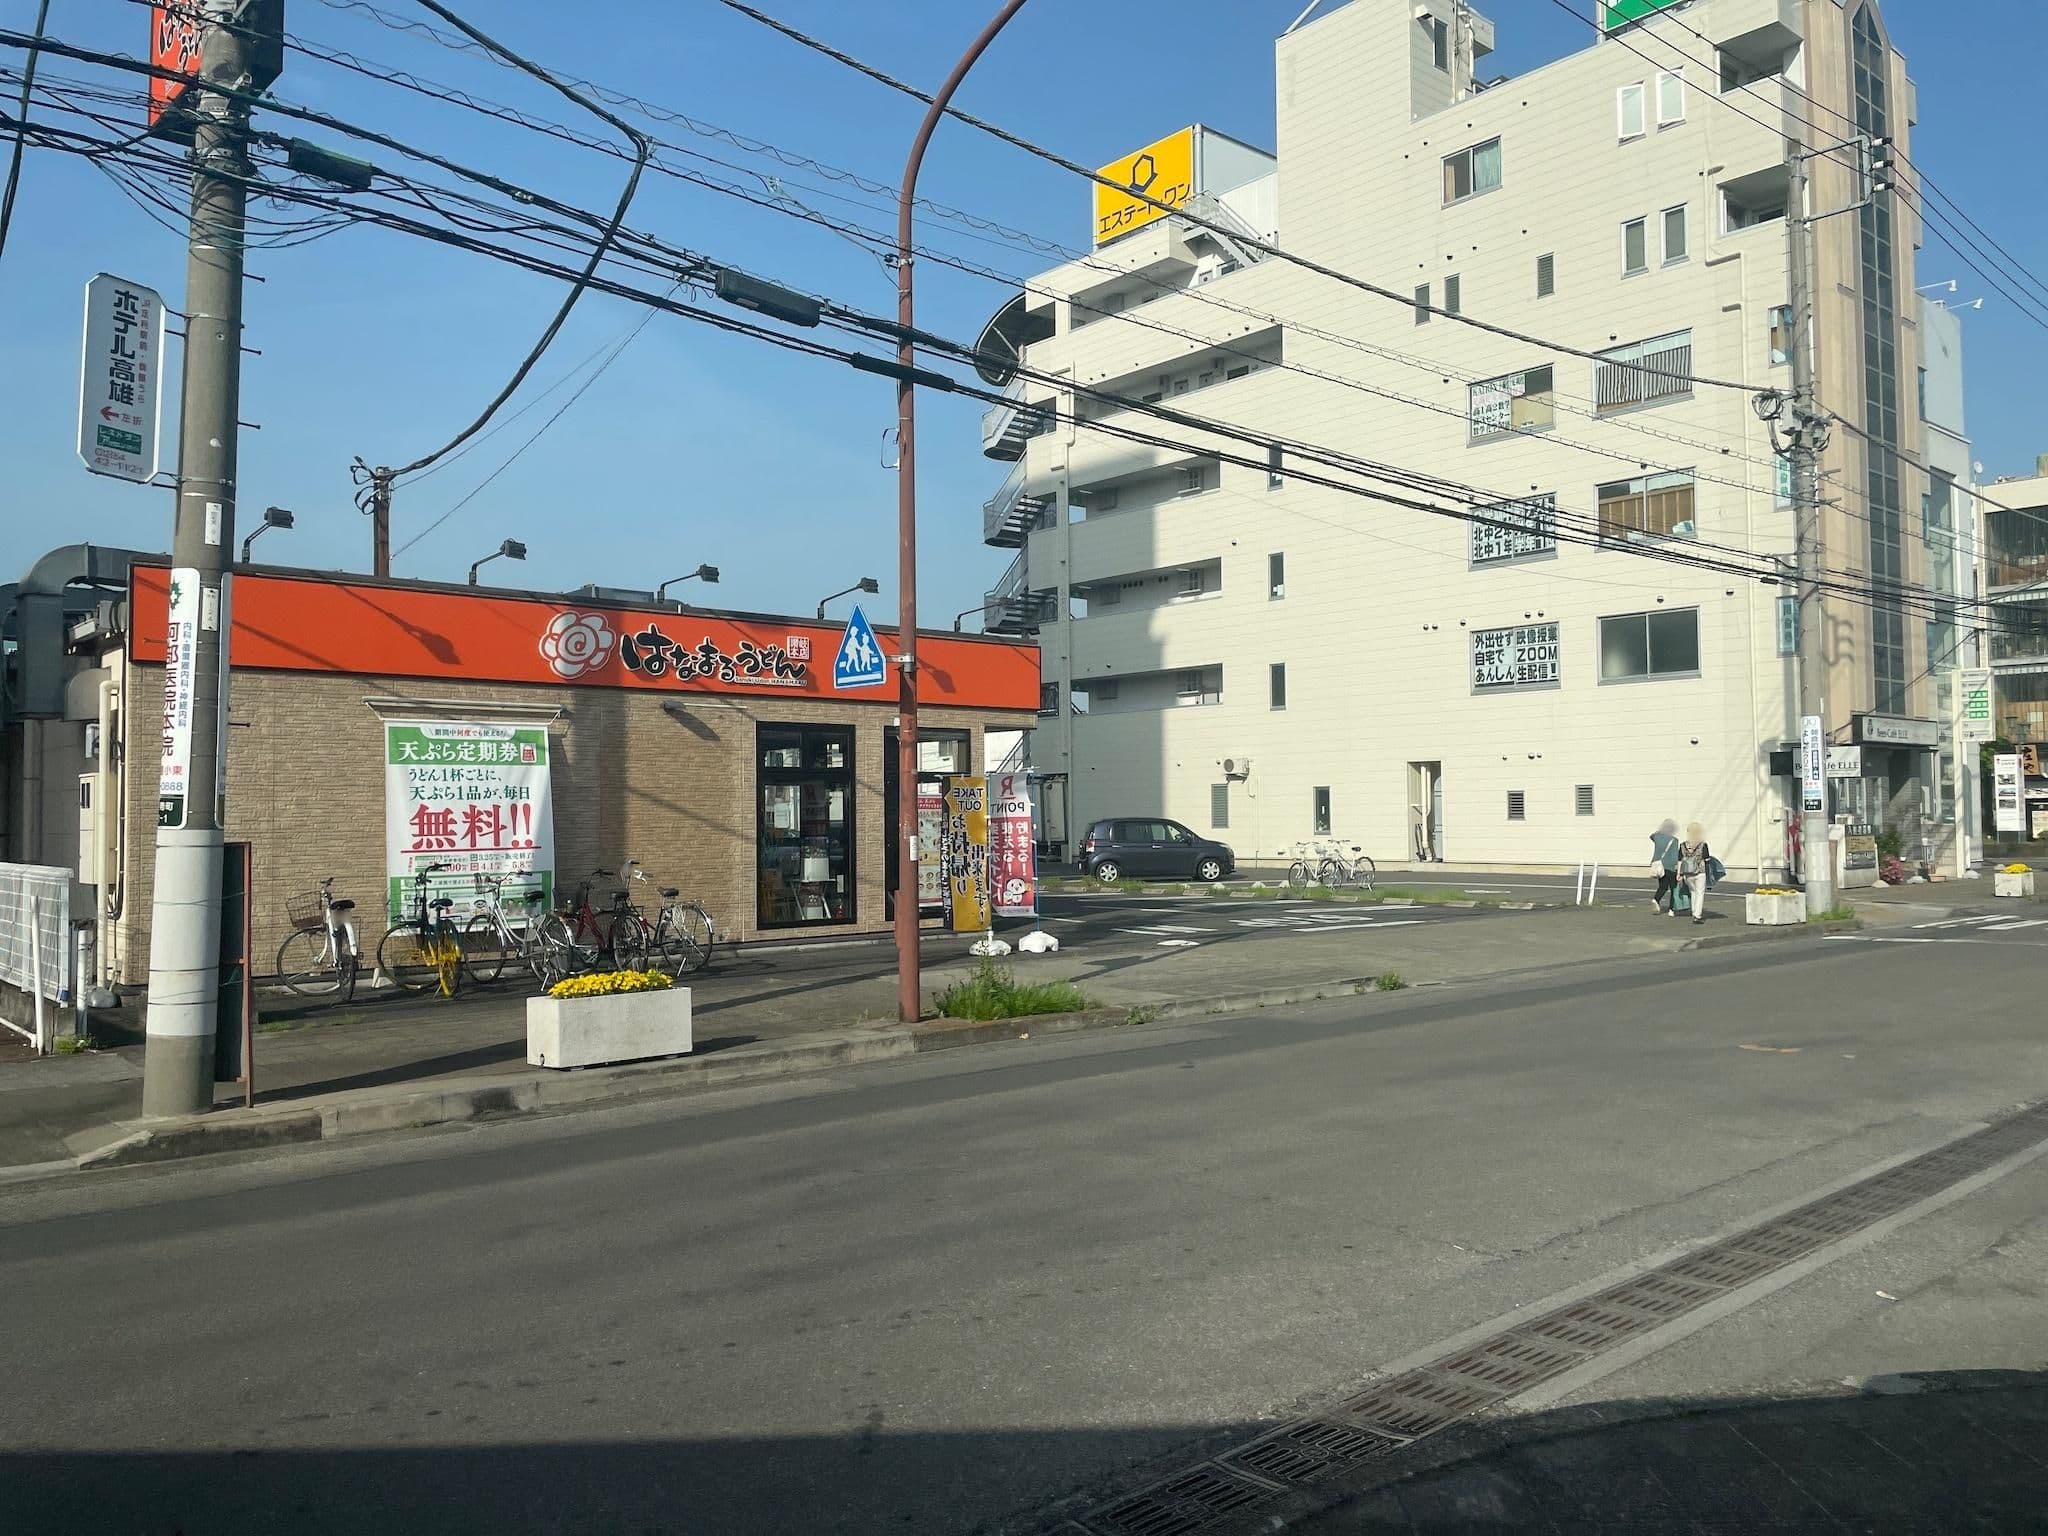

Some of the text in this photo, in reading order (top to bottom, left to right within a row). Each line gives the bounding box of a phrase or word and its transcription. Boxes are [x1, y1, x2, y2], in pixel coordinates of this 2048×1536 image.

[109, 289, 140, 406] ホテル高雄
[1473, 540, 1512, 558] 北中1年
[1475, 632, 1513, 649] 外出せず
[620, 623, 807, 683] はなまるうどん
[1475, 649, 1504, 666] 自宅で
[1517, 646, 1558, 662] ZOOM
[1475, 666, 1515, 682] あんしん
[398, 741, 519, 762] 天ぷら定期券
[1838, 761, 1860, 769] ELLE
[409, 768, 502, 782] うどん1杯ごとに、
[410, 785, 531, 801] 天ぷら1品が、毎日
[409, 803, 534, 850] 無料!!
